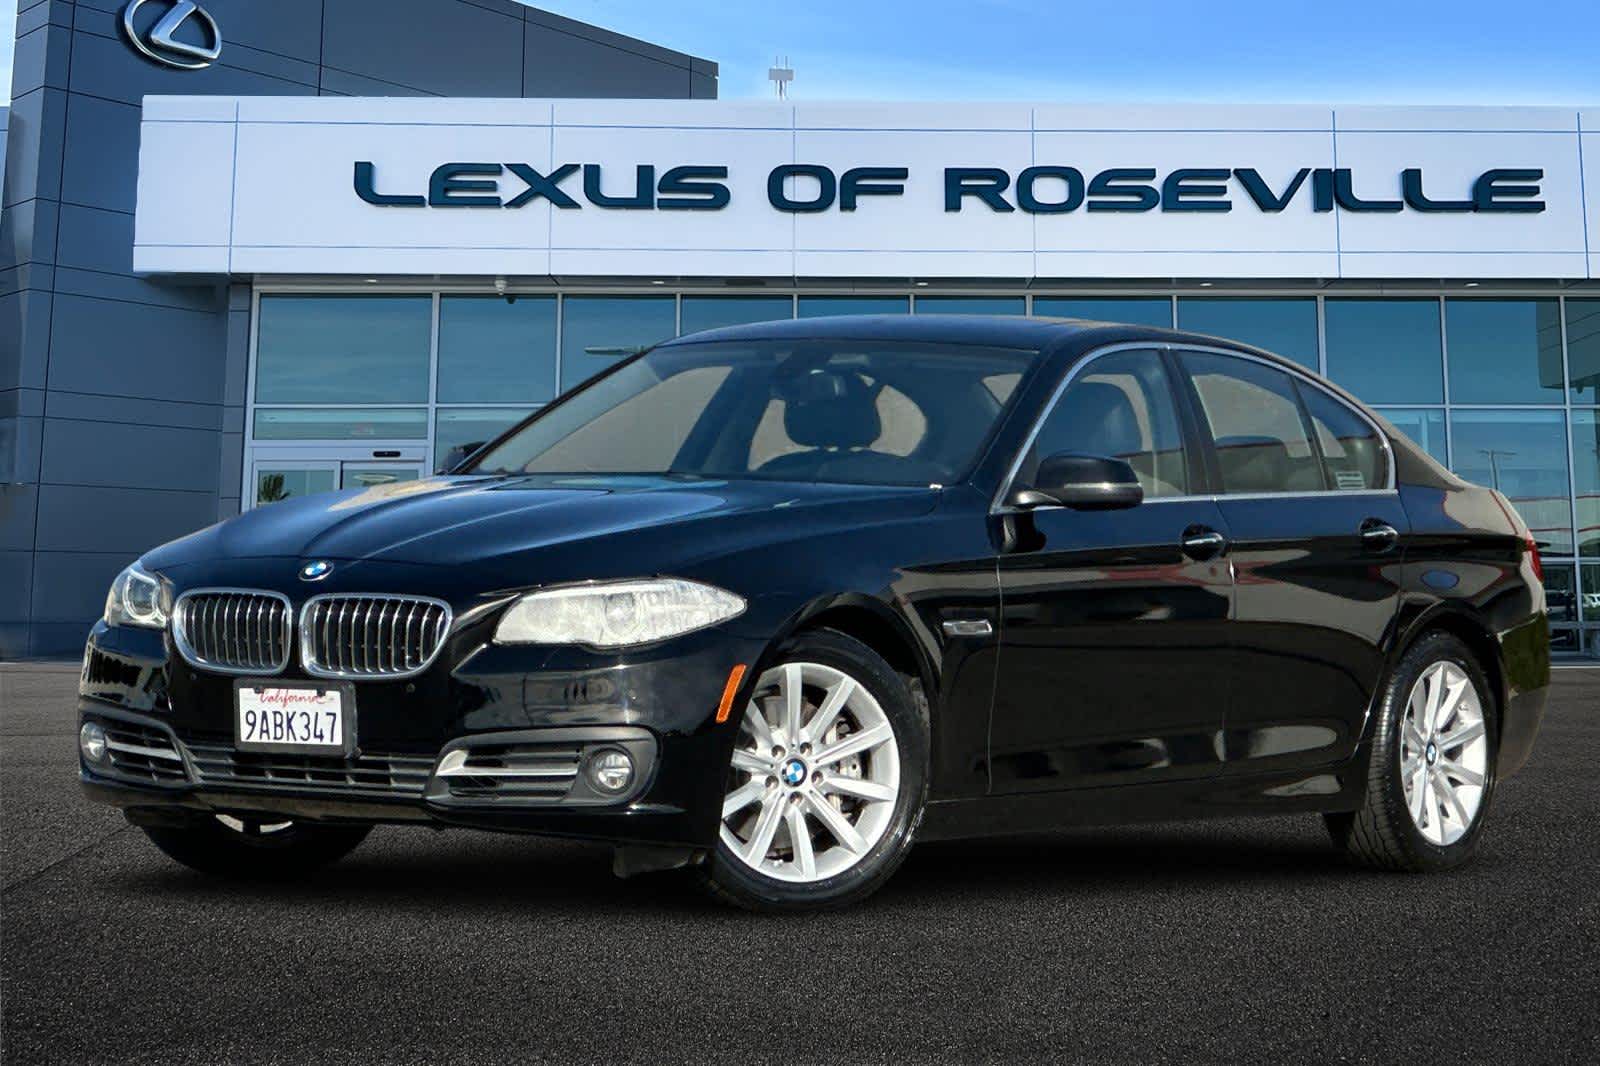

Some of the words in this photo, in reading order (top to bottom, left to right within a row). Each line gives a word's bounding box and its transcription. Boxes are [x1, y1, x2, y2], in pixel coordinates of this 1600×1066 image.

[354, 161, 731, 210] LEXUS
[767, 164, 908, 213] OF
[944, 166, 1546, 215] ROSEVILLE
[245, 710, 336, 742] 9ABK347
